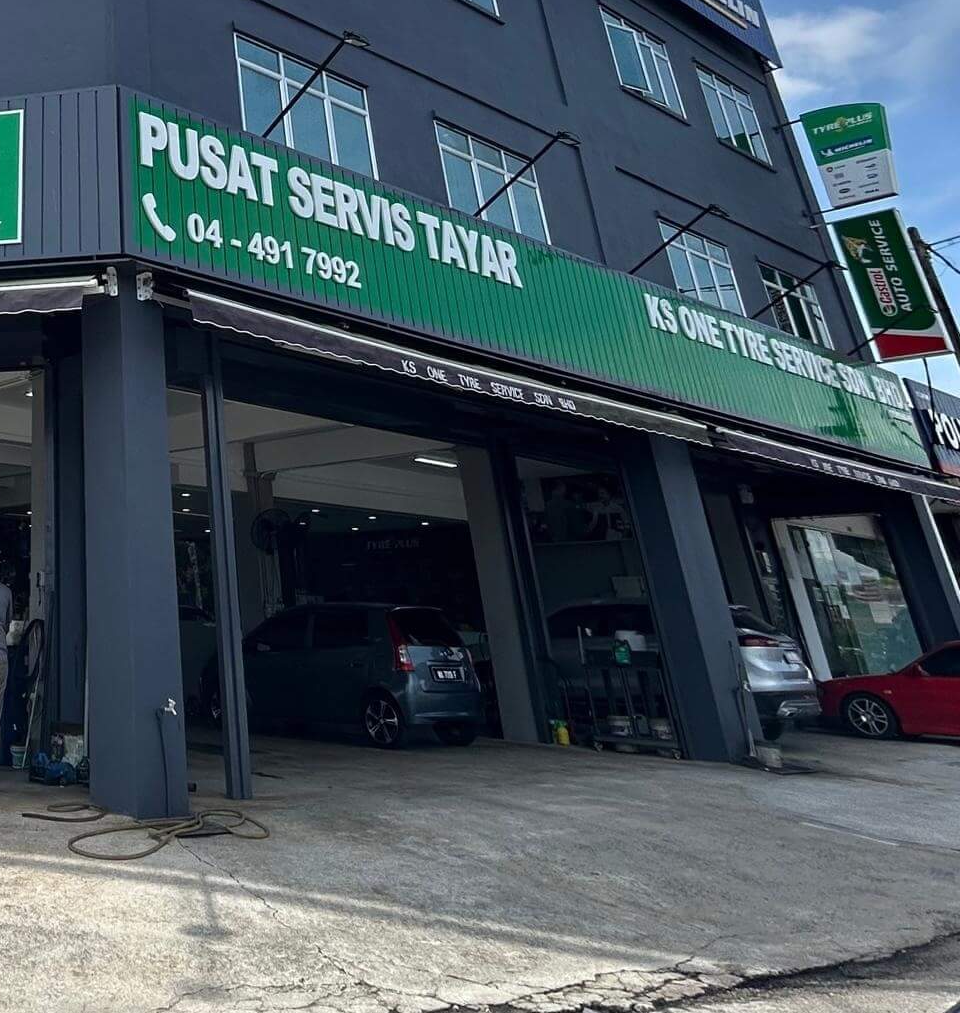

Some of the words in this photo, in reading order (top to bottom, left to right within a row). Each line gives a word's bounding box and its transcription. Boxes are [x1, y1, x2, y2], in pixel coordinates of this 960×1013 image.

[138, 111, 279, 206] PUSAT
[287, 166, 417, 252] SERVIS
[415, 210, 524, 288] TAYAR
[186, 212, 224, 249] 04
[247, 231, 293, 269] 491
[300, 246, 363, 289] 7992
[869, 219, 898, 273] SERVICE
[890, 277, 913, 312] AUTO
[643, 292, 678, 334] KS
[678, 305, 724, 349] ONE
[719, 320, 774, 366] TYRE
[769, 338, 842, 389] SERVICE
[401, 359, 417, 375] KS
[426, 366, 448, 382] ONE
[457, 373, 481, 390] TYRE
[490, 382, 524, 400] SERVICE
[534, 392, 553, 406] SDN
